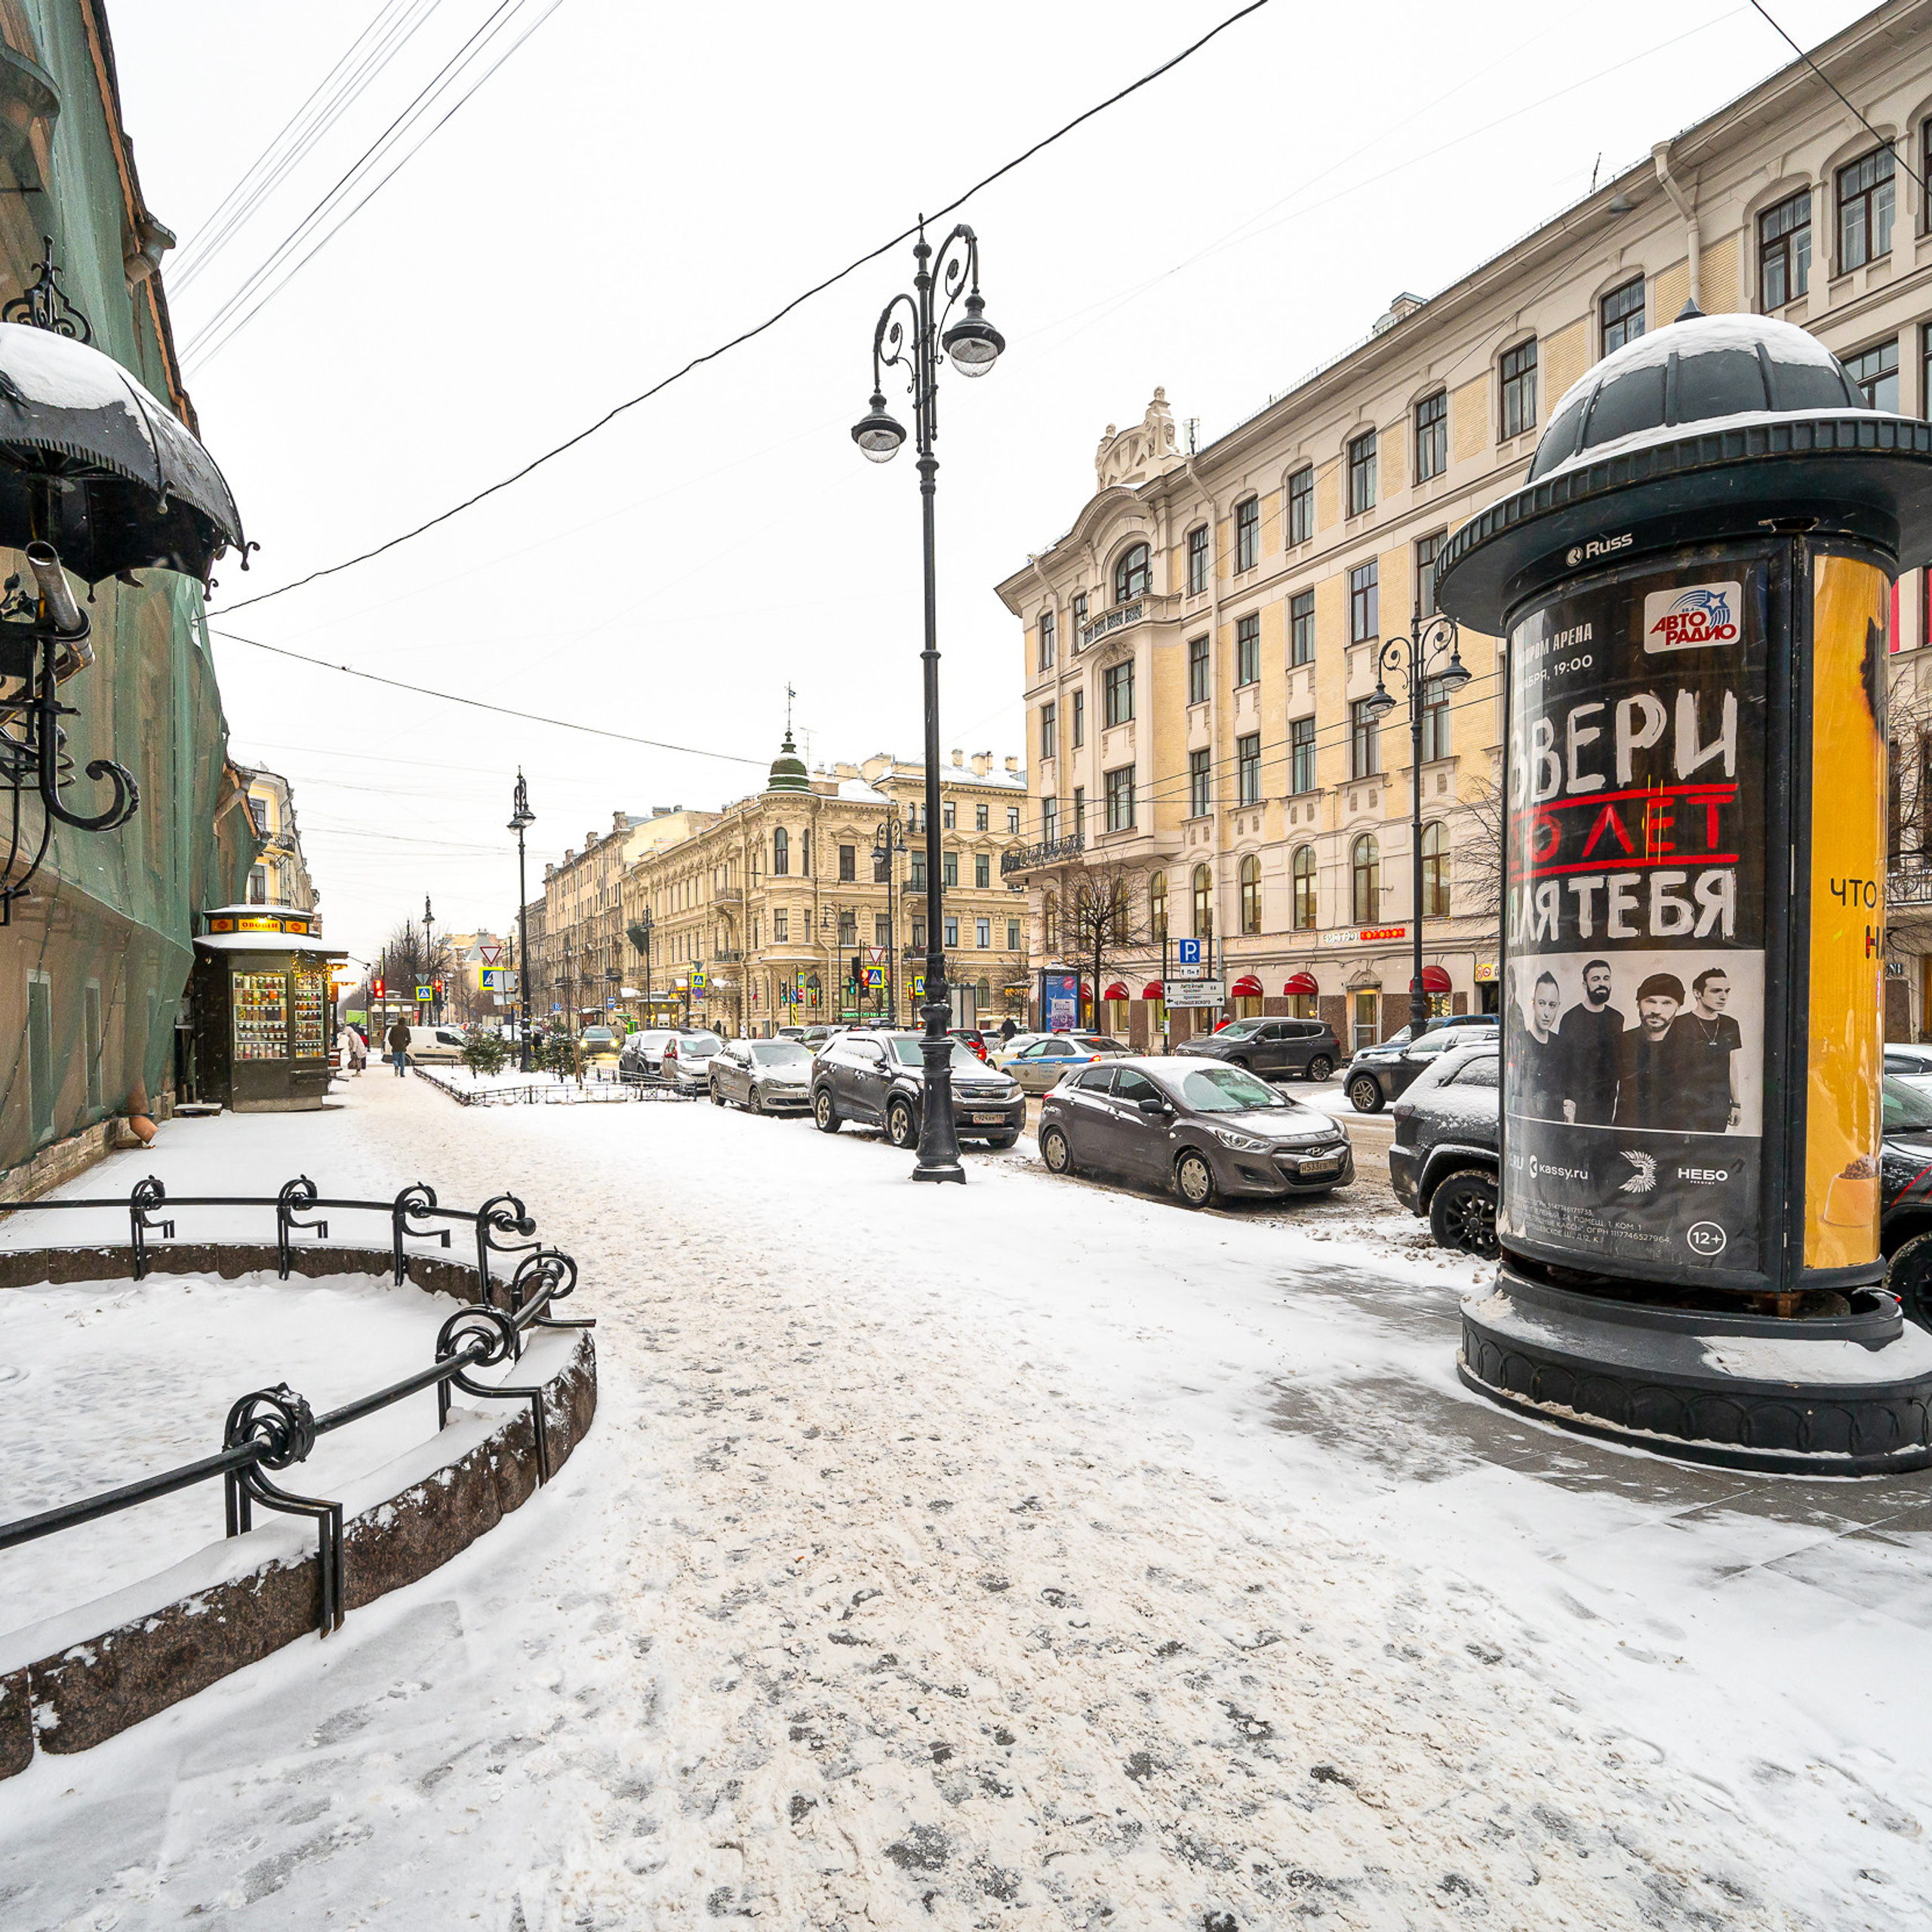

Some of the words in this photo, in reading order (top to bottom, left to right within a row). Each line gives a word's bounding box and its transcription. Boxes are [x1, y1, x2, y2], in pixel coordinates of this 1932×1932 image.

[1586, 533, 1633, 559] Russ
[1650, 611, 1706, 634] АВТО
[1666, 624, 1737, 645] РАДИО
[1553, 623, 1592, 651] АРЕНА
[1554, 654, 1593, 676] 19:00
[1510, 688, 1737, 810] ЗВЕРИ
[1582, 794, 1734, 857] ЛЕТ
[1567, 868, 1736, 940] ТЕБЯ
[1830, 877, 1877, 909] ЧТО
[1539, 1164, 1589, 1180] kassy.ru
[1678, 1168, 1728, 1182] НЕБО
[1693, 1232, 1723, 1245] 12+
